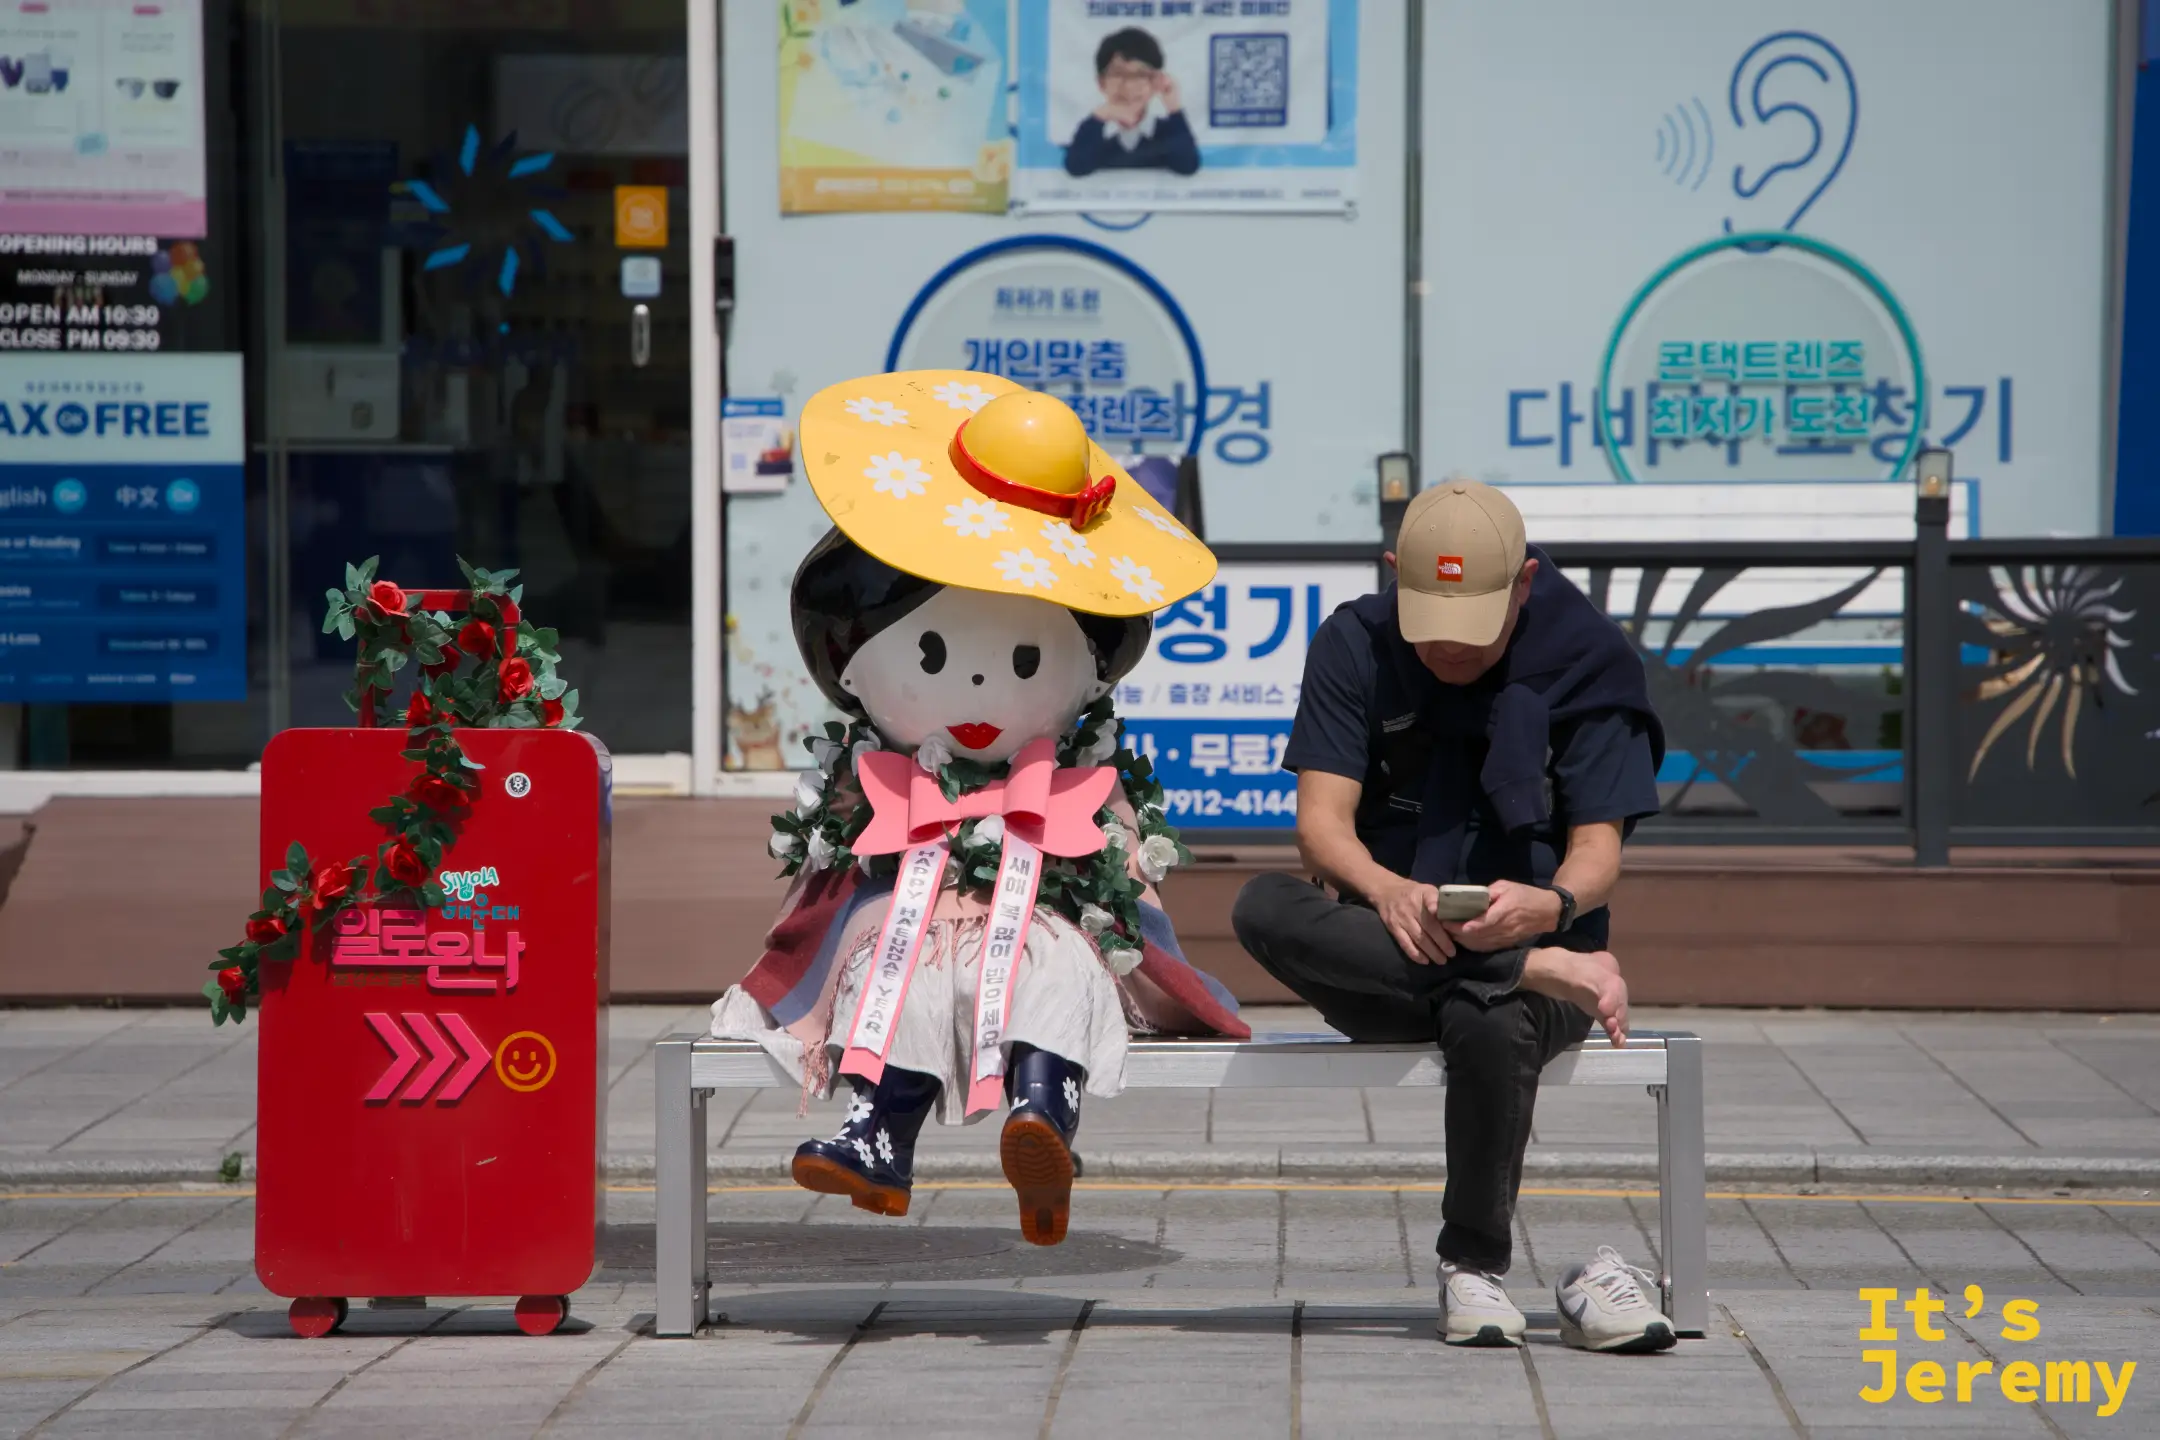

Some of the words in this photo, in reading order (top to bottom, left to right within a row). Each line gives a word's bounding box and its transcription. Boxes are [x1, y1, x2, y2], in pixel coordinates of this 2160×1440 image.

[0, 234, 87, 256] OPENING
[89, 236, 158, 256] HOURS
[16, 269, 75, 286] MONDAY
[84, 270, 138, 286] SUNDAY
[0, 303, 61, 325] OPEN
[66, 304, 100, 325] AM
[0, 327, 62, 348] CLOSE
[67, 328, 100, 349] PM
[964, 338, 1125, 380] 개인맞춤
[1658, 341, 1864, 380] 콘택트렌즈
[95, 402, 210, 438] FREE
[1652, 396, 1775, 436] 최저가
[1790, 396, 1870, 436] 도전
[1219, 683, 1284, 705] 서비스
[907, 850, 936, 900] HAPPY
[441, 893, 520, 930] 해운대
[332, 909, 526, 989] 일로온나
[882, 906, 917, 981] HAEUNDAE
[865, 984, 893, 1034] YEAR
